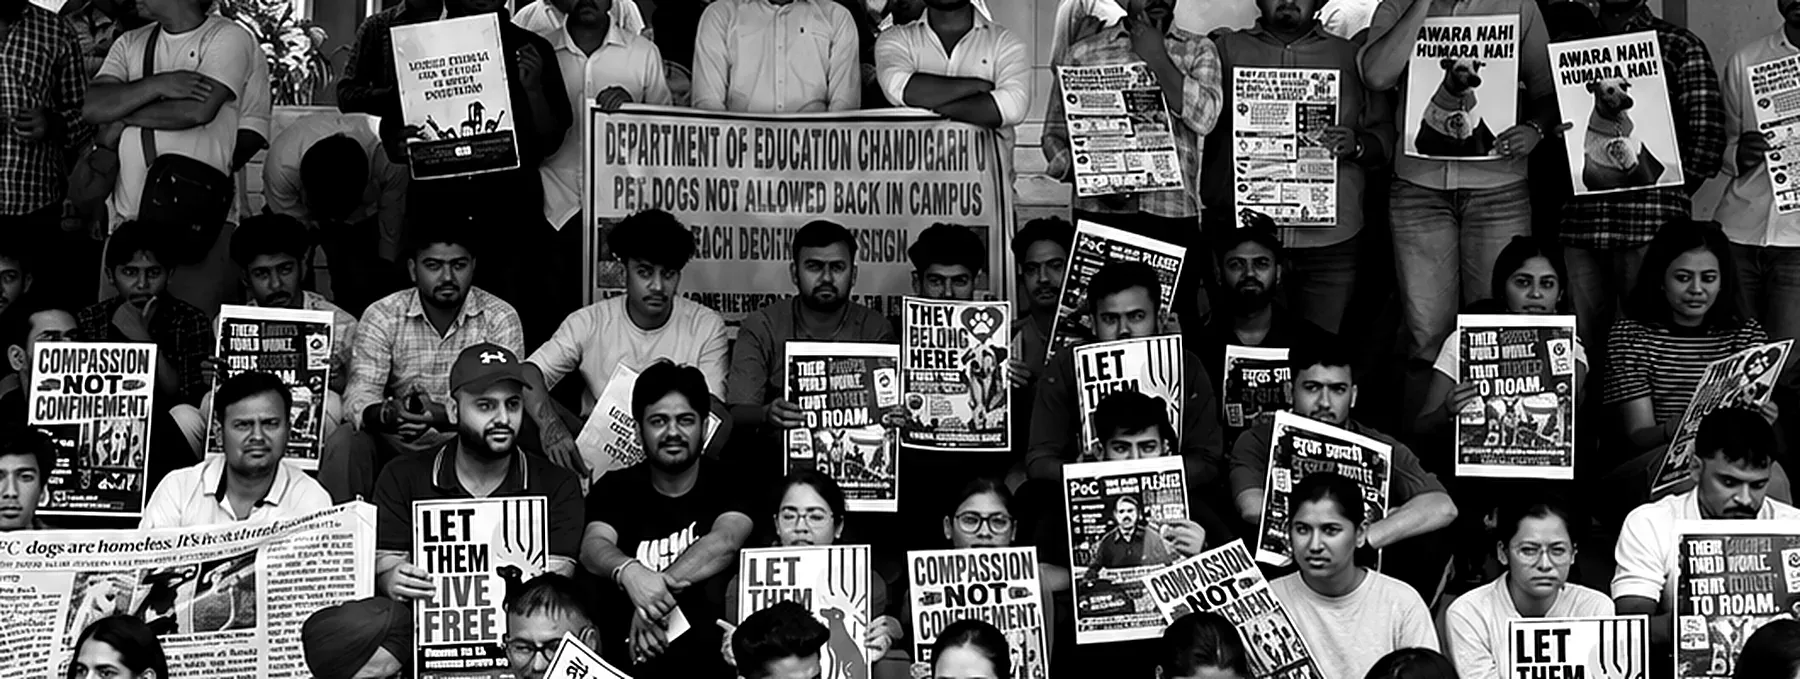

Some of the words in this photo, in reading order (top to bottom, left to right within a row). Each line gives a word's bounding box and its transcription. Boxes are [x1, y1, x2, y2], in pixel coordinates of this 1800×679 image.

[1417, 26, 1472, 42] AWARA
[1416, 43, 1478, 59] HUMARA
[1484, 43, 1514, 58] HAI!
[1558, 47, 1612, 69] AWARA
[1627, 61, 1659, 80] HAI!
[605, 122, 720, 168] DEPARTMENT
[726, 127, 748, 169] OF
[754, 127, 851, 171] EDUCATION
[858, 128, 969, 172] CHANDIGARH
[652, 177, 699, 211] DOGS
[706, 178, 739, 212] NOT
[745, 179, 826, 214] ALLOWED
[834, 181, 881, 214] BACK
[886, 182, 903, 215] IN
[909, 182, 983, 216] CAMPUS
[909, 304, 955, 327] THEY
[38, 348, 150, 374] COMPASSION
[910, 349, 959, 369] HERE
[1081, 349, 1126, 383] LET
[62, 374, 123, 395] NOT
[423, 509, 476, 543] LET
[423, 543, 489, 574] THEM
[748, 556, 801, 587] LET
[914, 551, 1035, 586] COMPASSION
[1151, 544, 1254, 604] COMPASSION
[943, 582, 1008, 609] NOT
[1185, 577, 1240, 614] NOT
[1690, 595, 1714, 616] TO
[1719, 592, 1781, 616] ROAM.
[424, 607, 498, 643] FREE
[1516, 628, 1571, 664] LET
